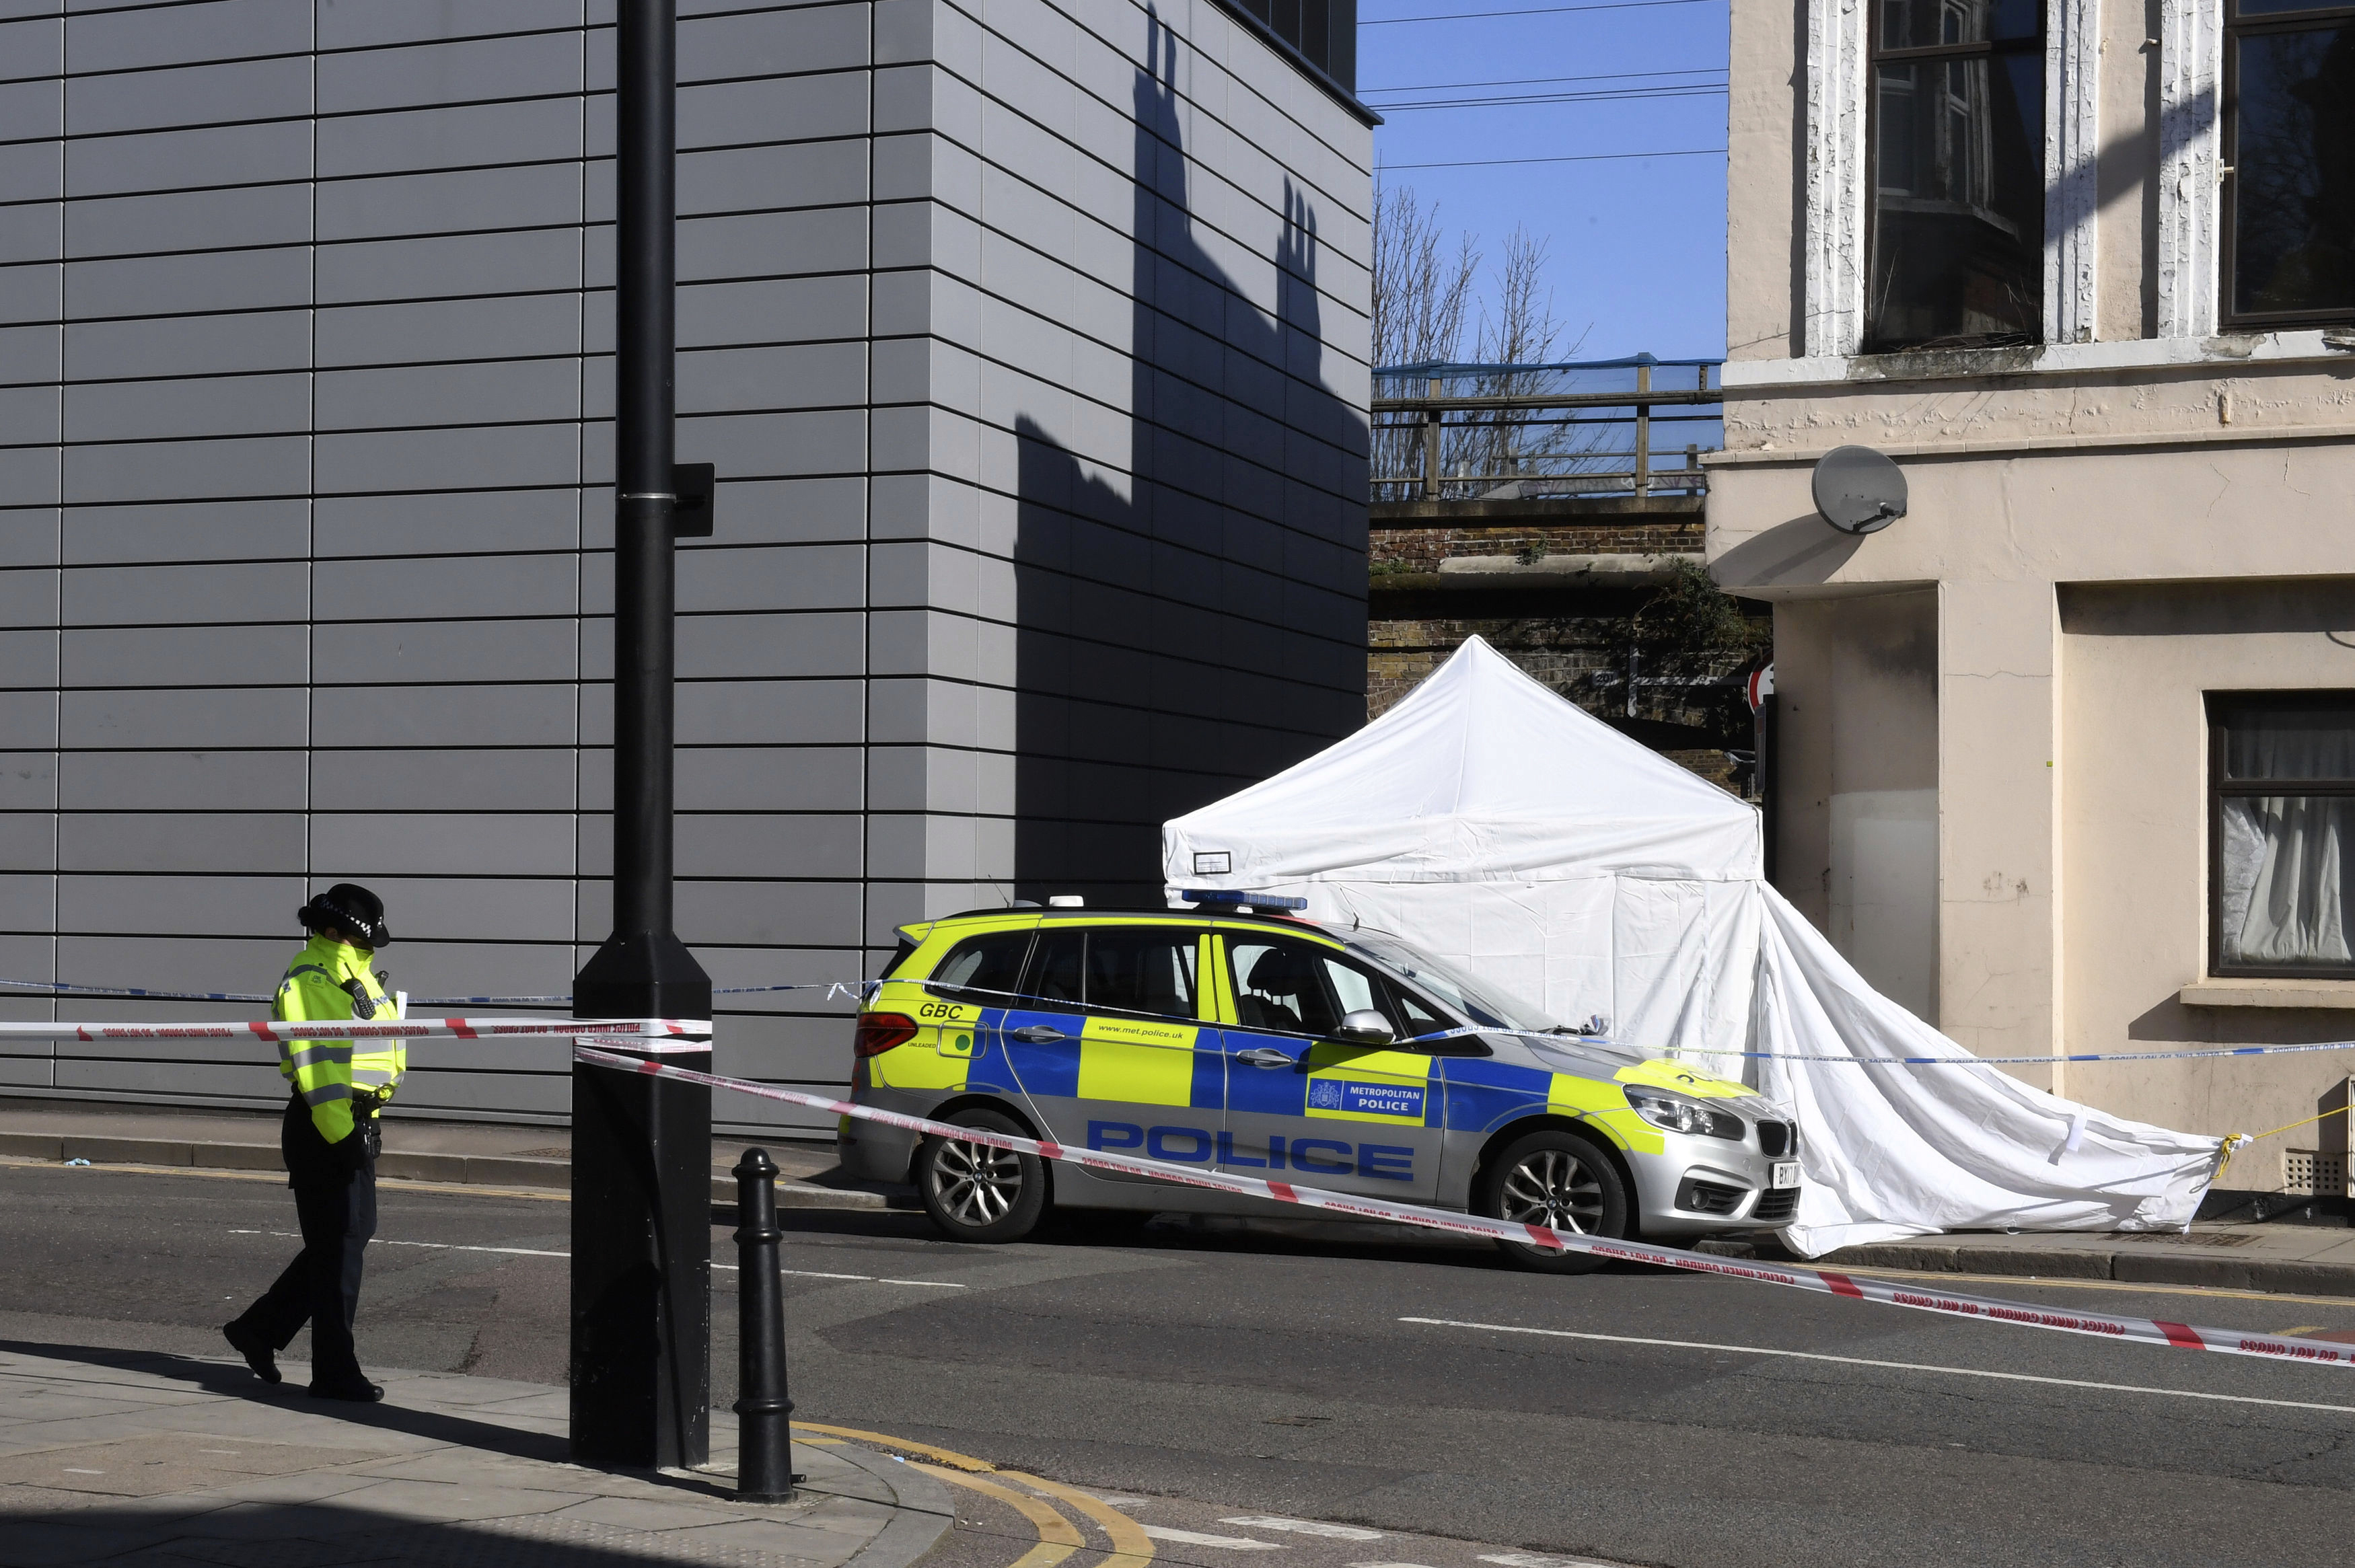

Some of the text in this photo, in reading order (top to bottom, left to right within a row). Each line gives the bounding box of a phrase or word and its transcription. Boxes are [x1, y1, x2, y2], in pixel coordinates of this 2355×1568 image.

[920, 1003, 964, 1019] GBC
[1099, 1024, 1184, 1039] www.met.police.uk
[1350, 1086, 1420, 1099] METROPOLITAN
[1358, 1098, 1409, 1111] POLICE
[1087, 1119, 1414, 1182] POLICE
[1892, 1292, 2125, 1335] POLICE INNER CORDON DO NOT CROSS
[2238, 1340, 2286, 1355] CROSS
[2285, 1346, 2316, 1359] NOT
[2317, 1350, 2338, 1361] DO
